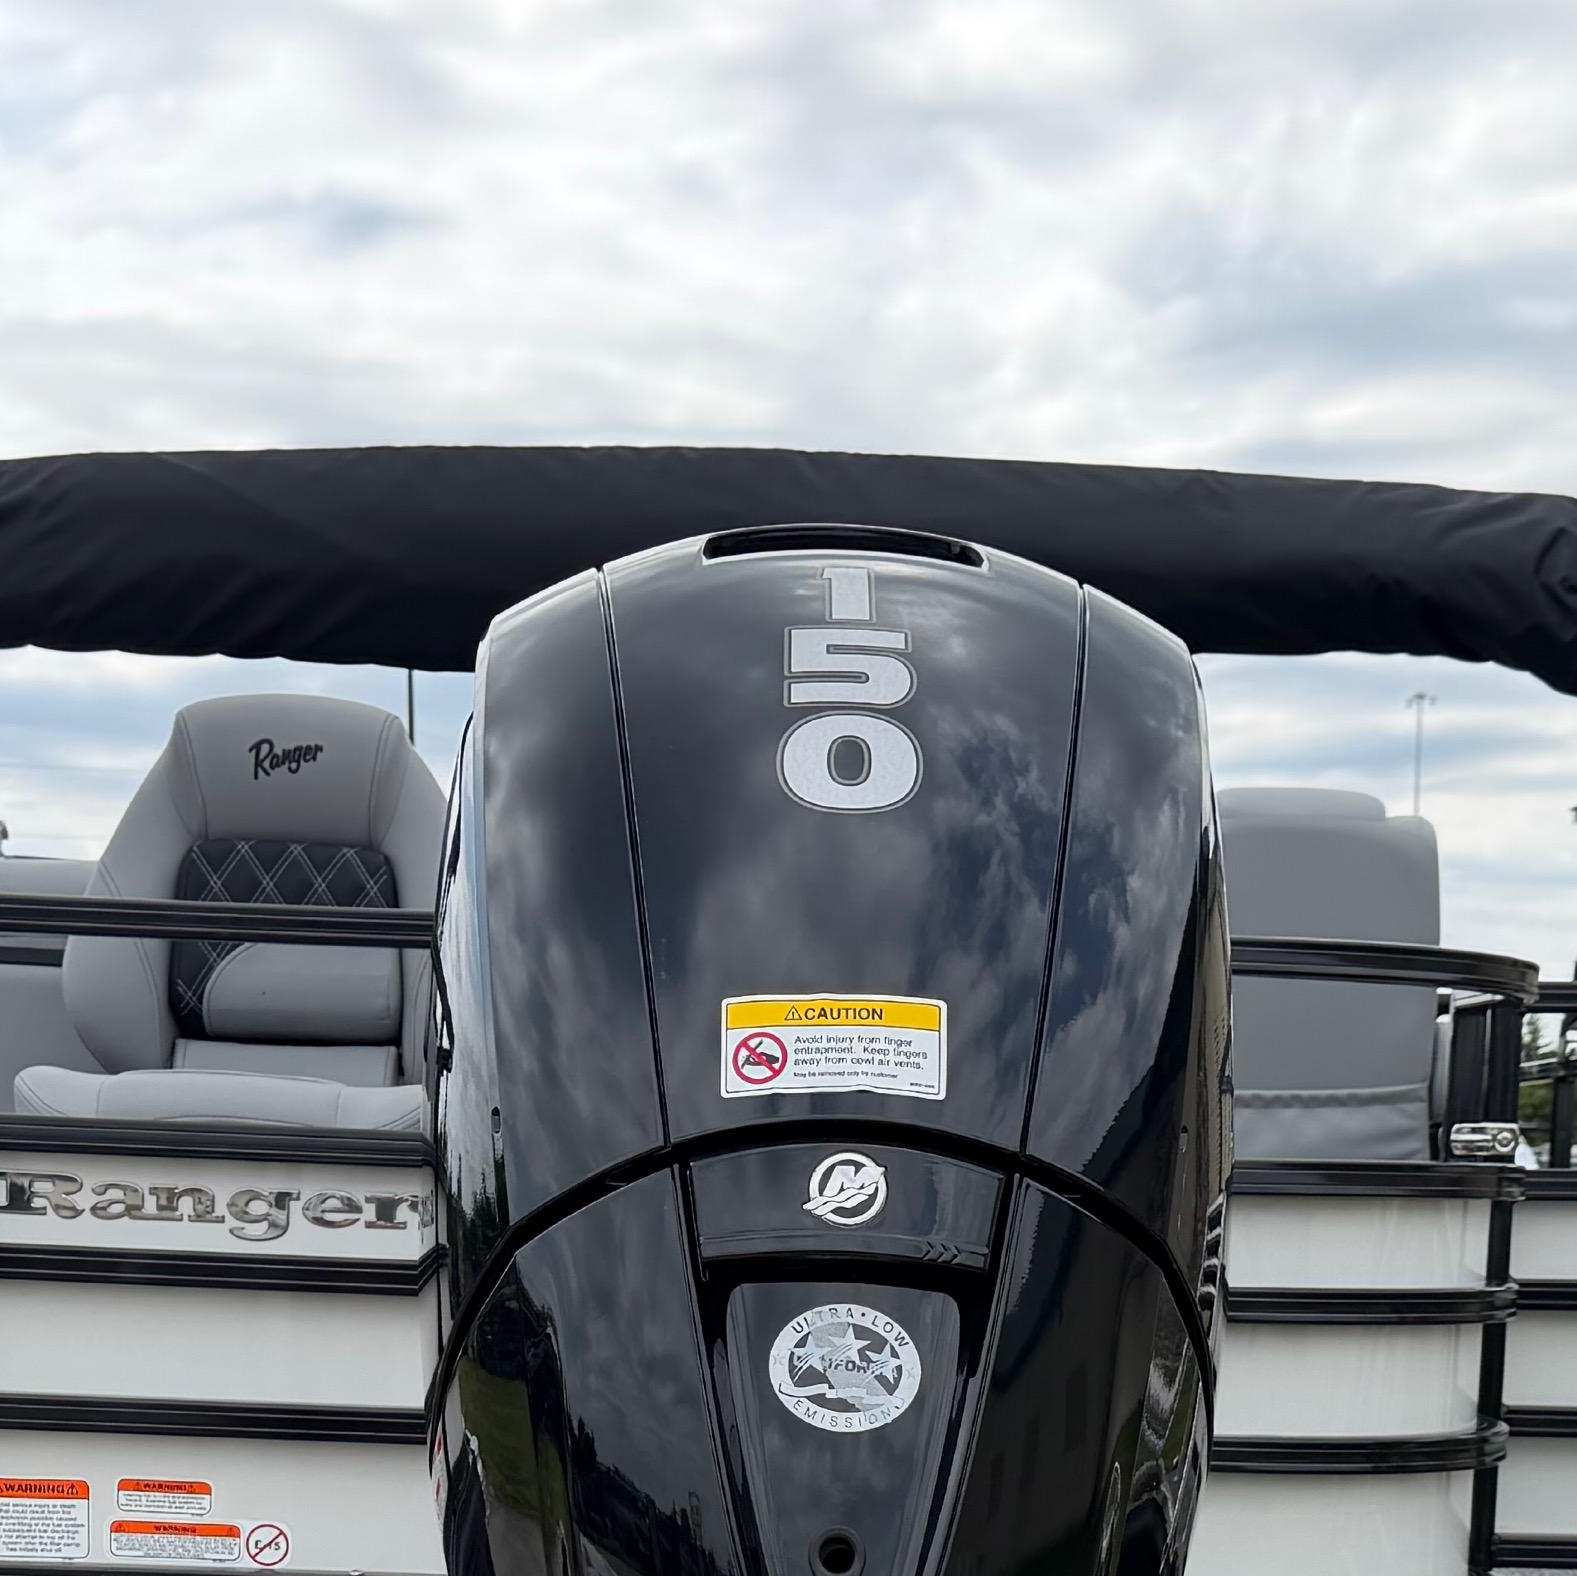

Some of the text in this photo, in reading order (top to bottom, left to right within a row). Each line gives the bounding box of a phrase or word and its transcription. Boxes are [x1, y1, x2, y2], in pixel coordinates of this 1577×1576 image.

[776, 567, 923, 813] 150
[248, 738, 324, 780] Ranger
[804, 1007, 883, 1020] CAUTION
[794, 1035, 913, 1048] Avoid injury from finger
[794, 1046, 928, 1060] entrapment. Keep fingers
[793, 1056, 924, 1070] away from cowl air vents.
[871, 1315, 910, 1347] LOW
[4, 1483, 65, 1494] WARNING
